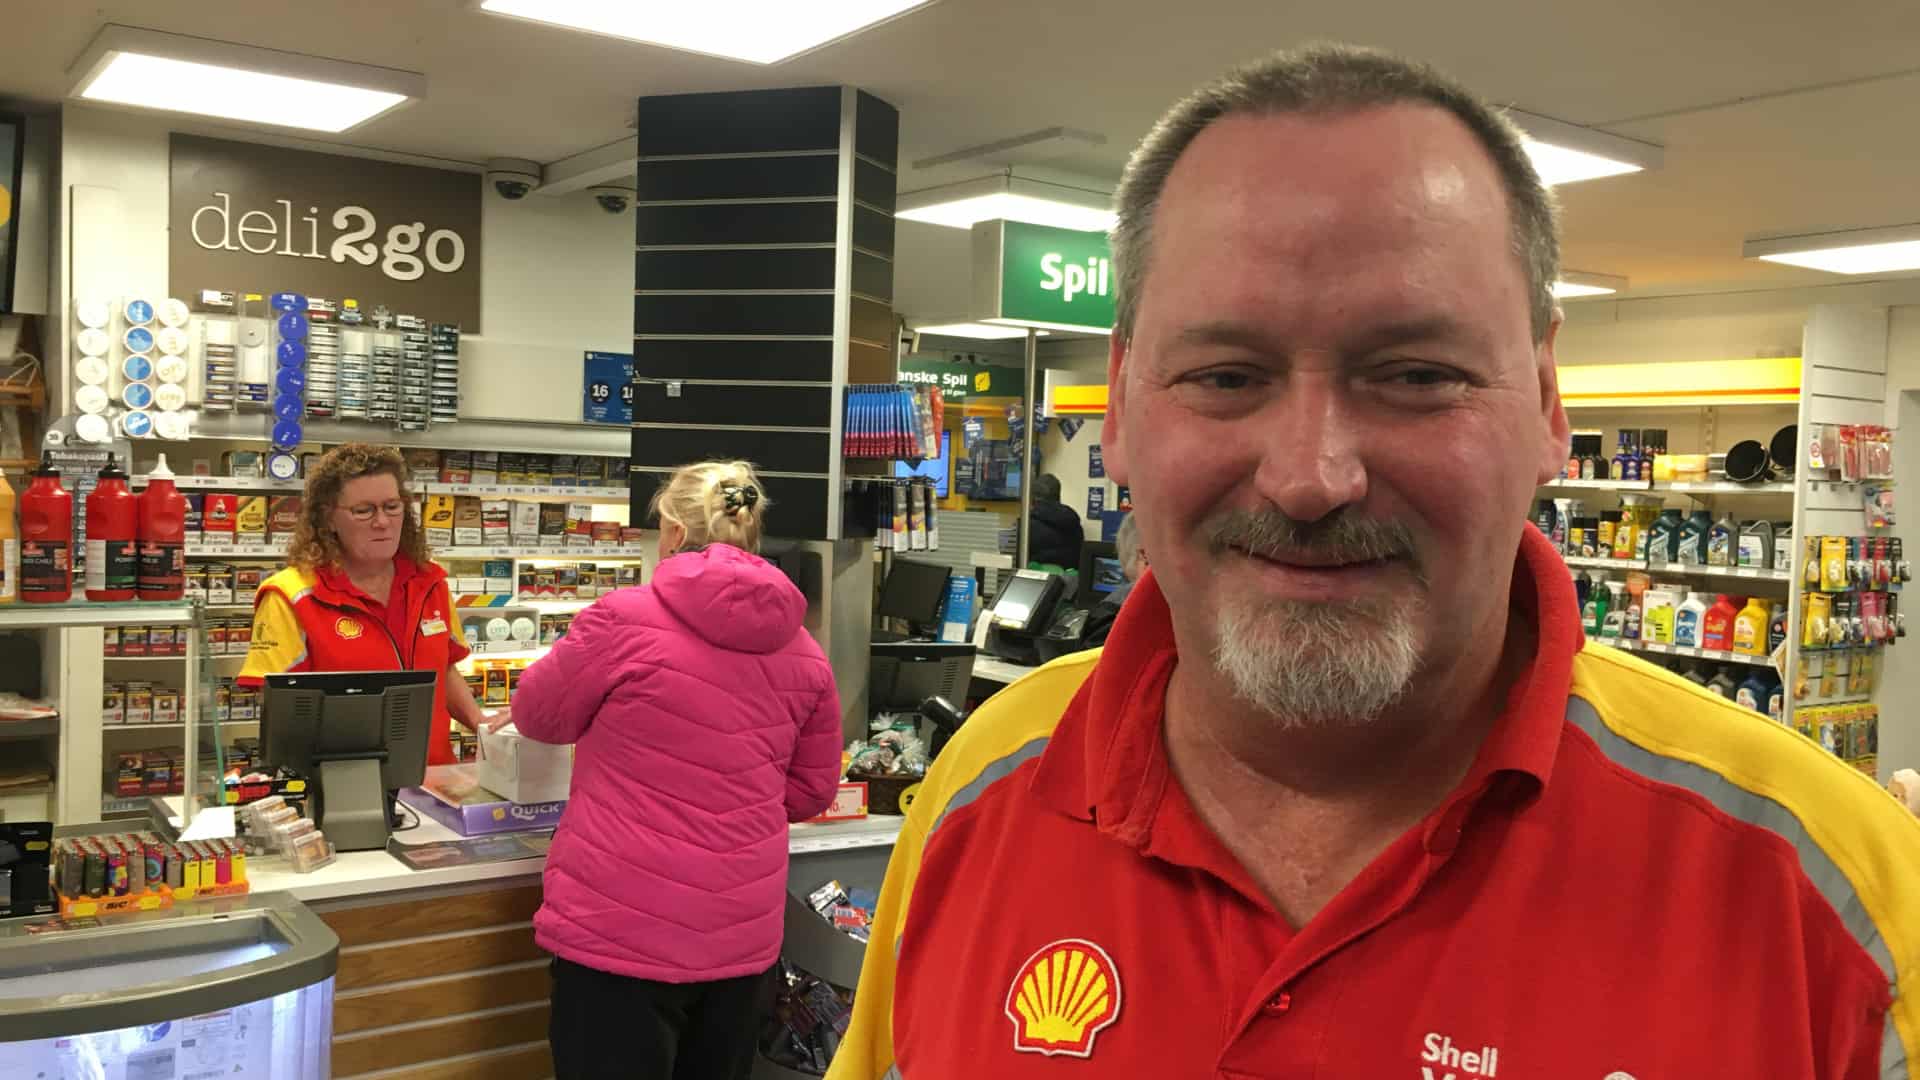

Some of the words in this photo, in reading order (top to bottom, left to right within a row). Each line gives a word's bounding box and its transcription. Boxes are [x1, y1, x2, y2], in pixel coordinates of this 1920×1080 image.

[191, 192, 466, 281] deli2go
[1039, 252, 1109, 302] Spil
[592, 384, 609, 398] 16
[897, 371, 938, 384] anske
[942, 372, 968, 388] Spil
[510, 803, 560, 821] QUICK
[1421, 1032, 1498, 1078] Shell
